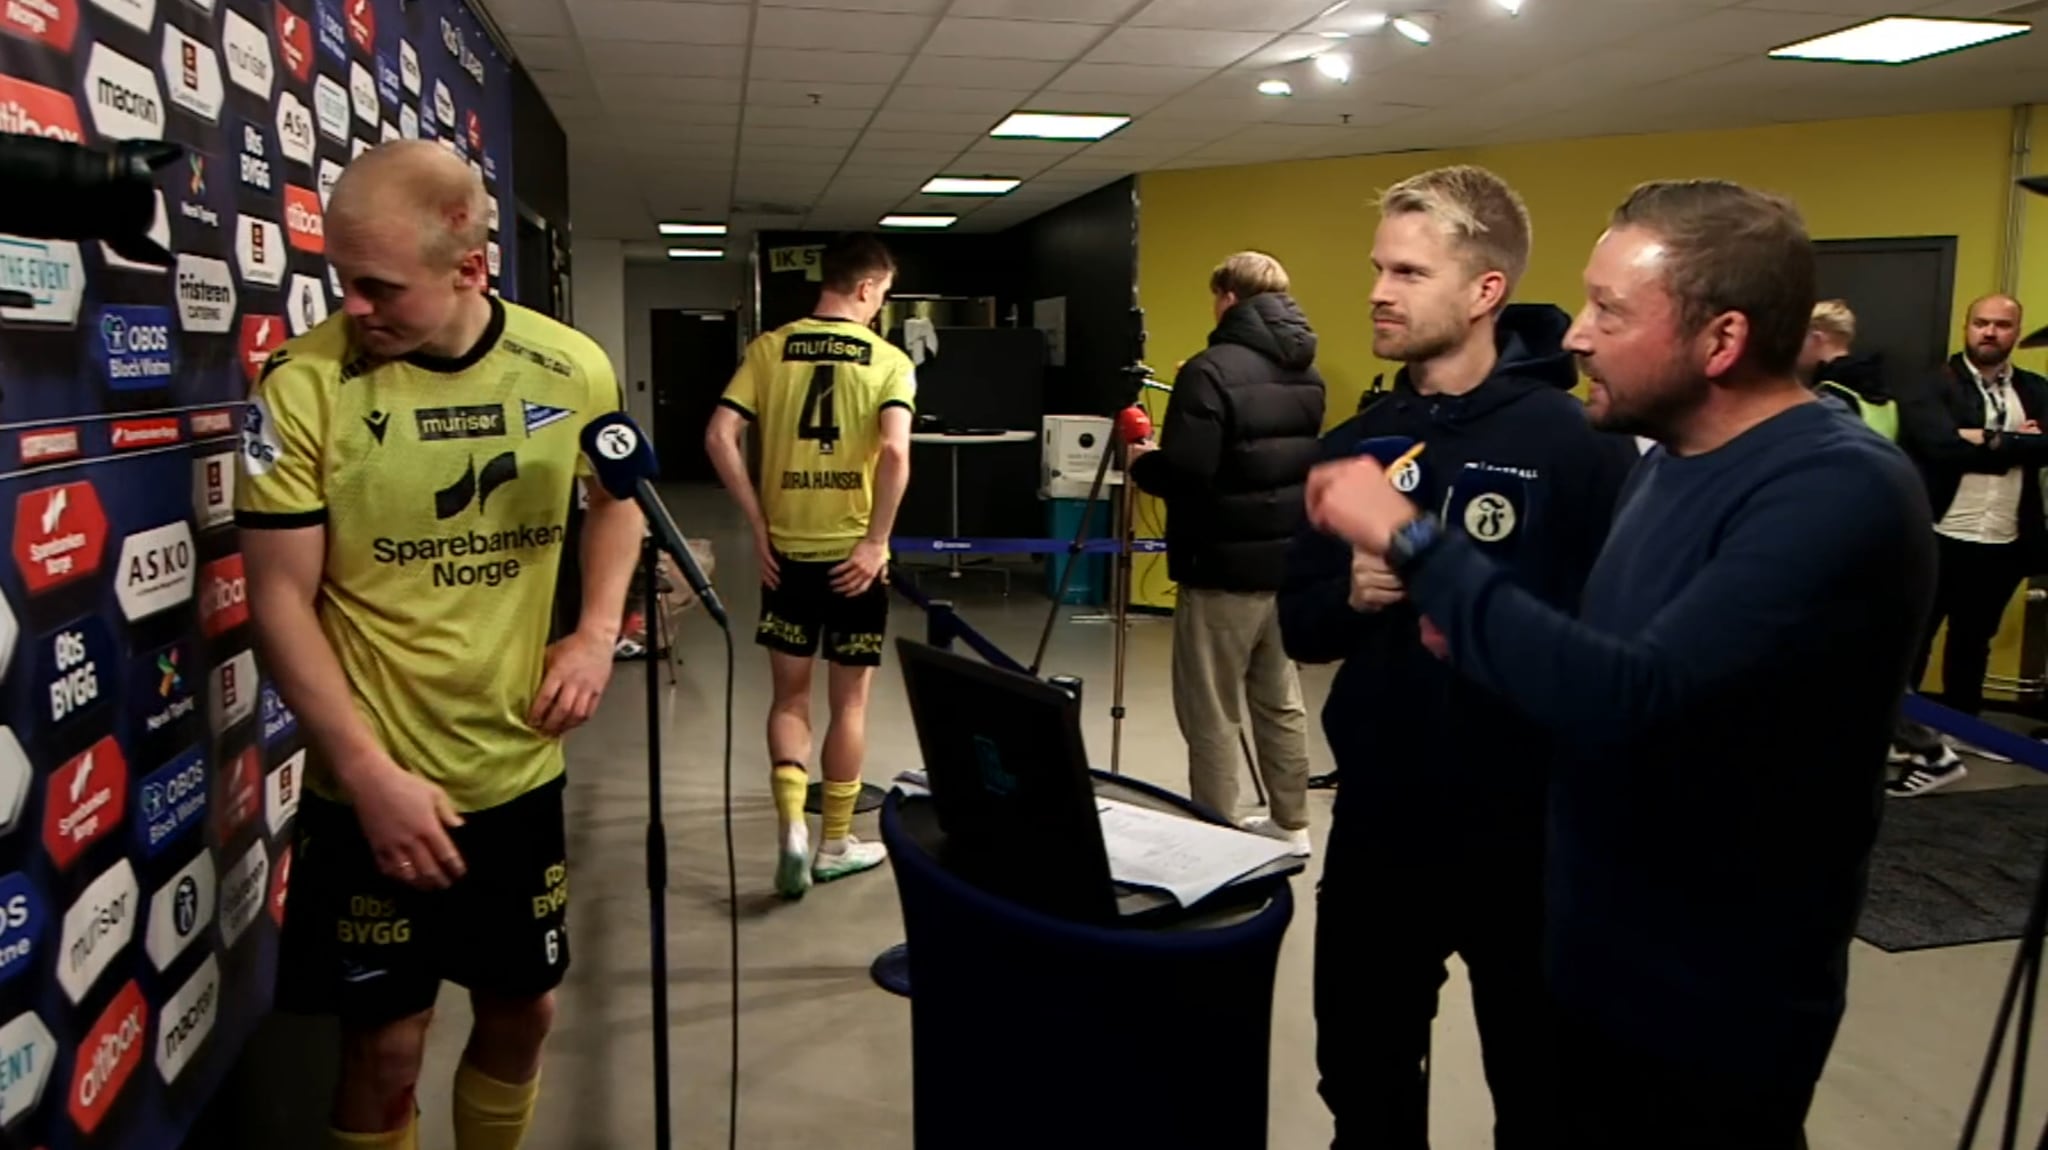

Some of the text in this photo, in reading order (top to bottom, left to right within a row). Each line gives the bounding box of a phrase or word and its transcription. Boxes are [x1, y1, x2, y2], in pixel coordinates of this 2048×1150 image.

[97, 77, 158, 125] macron
[775, 253, 796, 269] IK
[128, 325, 168, 351] OBOS
[798, 365, 841, 453] 4
[812, 471, 863, 490] HANSEN
[128, 540, 190, 587] ASKO
[372, 524, 564, 564] Sparebanken
[433, 556, 521, 588] Norge
[50, 661, 99, 723] BYGG
[166, 759, 204, 804] OBOS
[336, 918, 411, 944] BYGG
